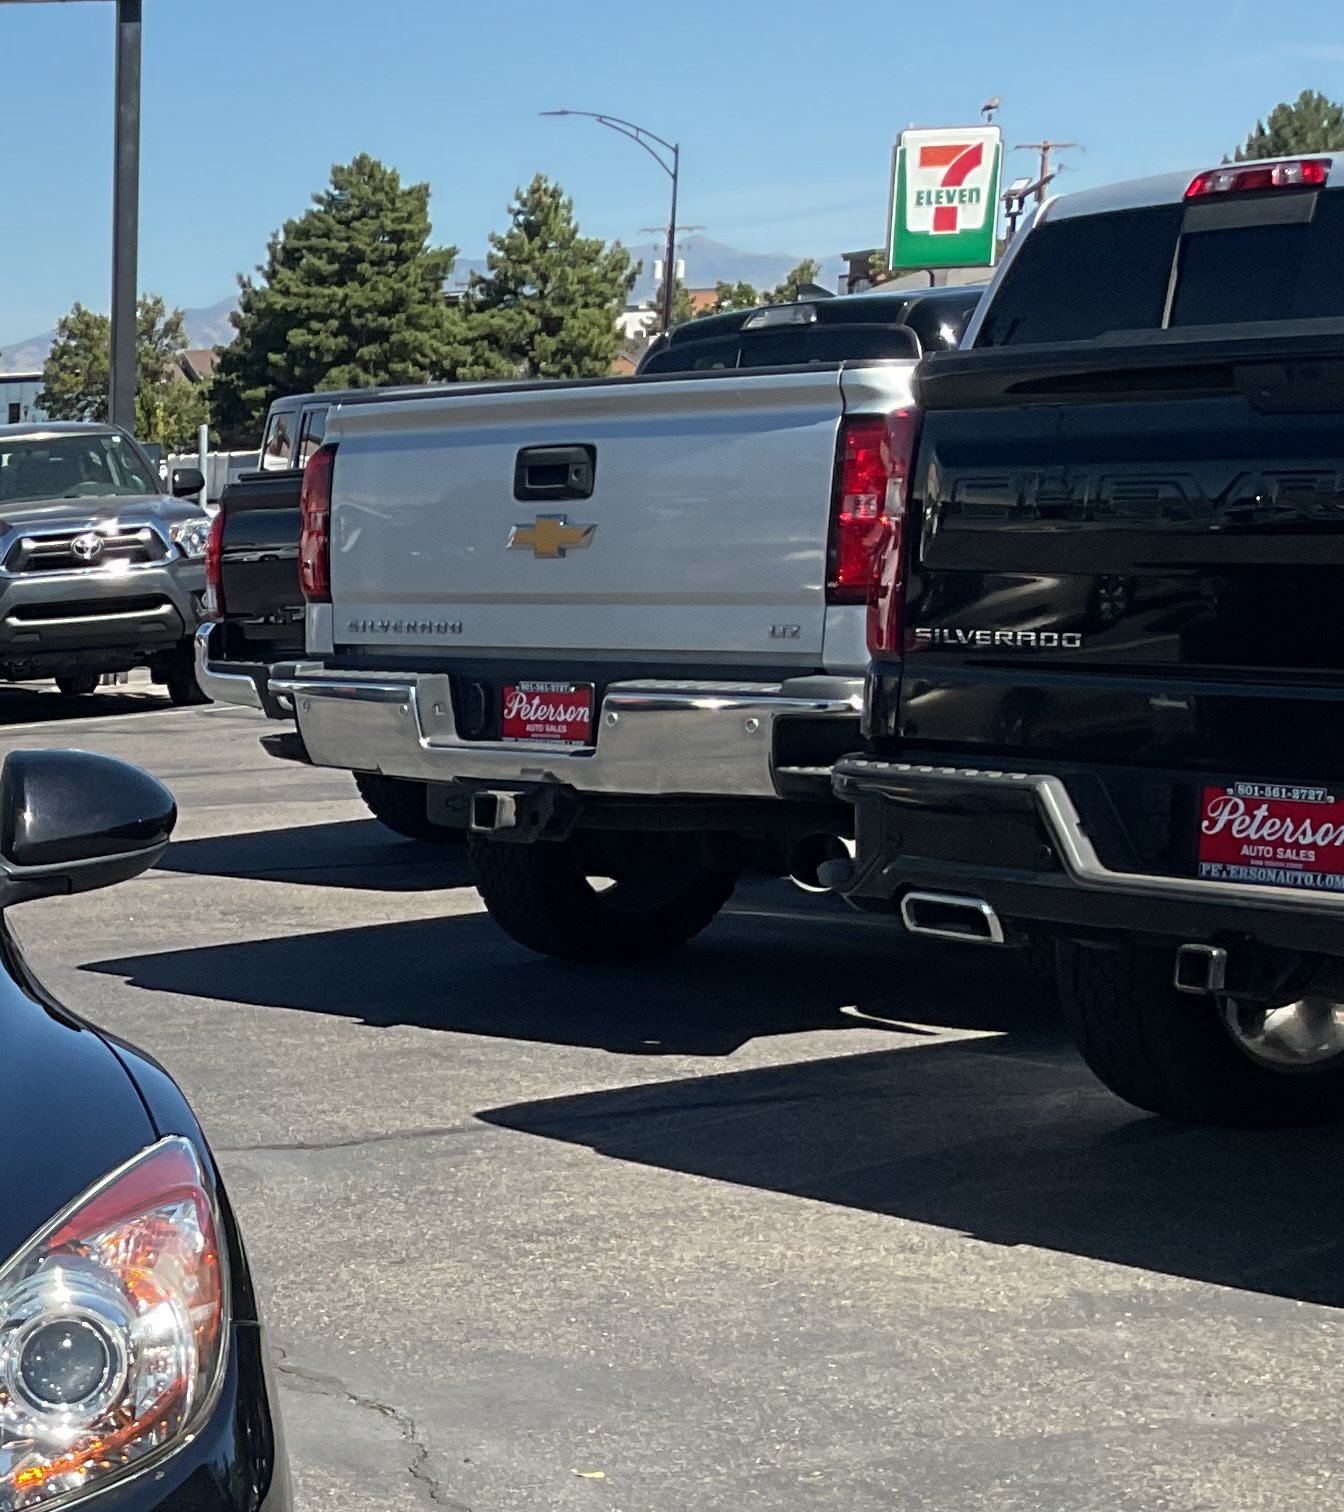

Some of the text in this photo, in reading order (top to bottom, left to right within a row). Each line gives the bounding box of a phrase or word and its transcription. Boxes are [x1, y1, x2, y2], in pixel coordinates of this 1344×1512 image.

[920, 142, 983, 231] 7
[915, 627, 1082, 648] SILVERADO
[504, 691, 589, 722] Peterson
[526, 723, 567, 733] AUTO SALES
[1237, 784, 1324, 801] 801-561-2727
[1240, 844, 1316, 862] AUTO SALES
